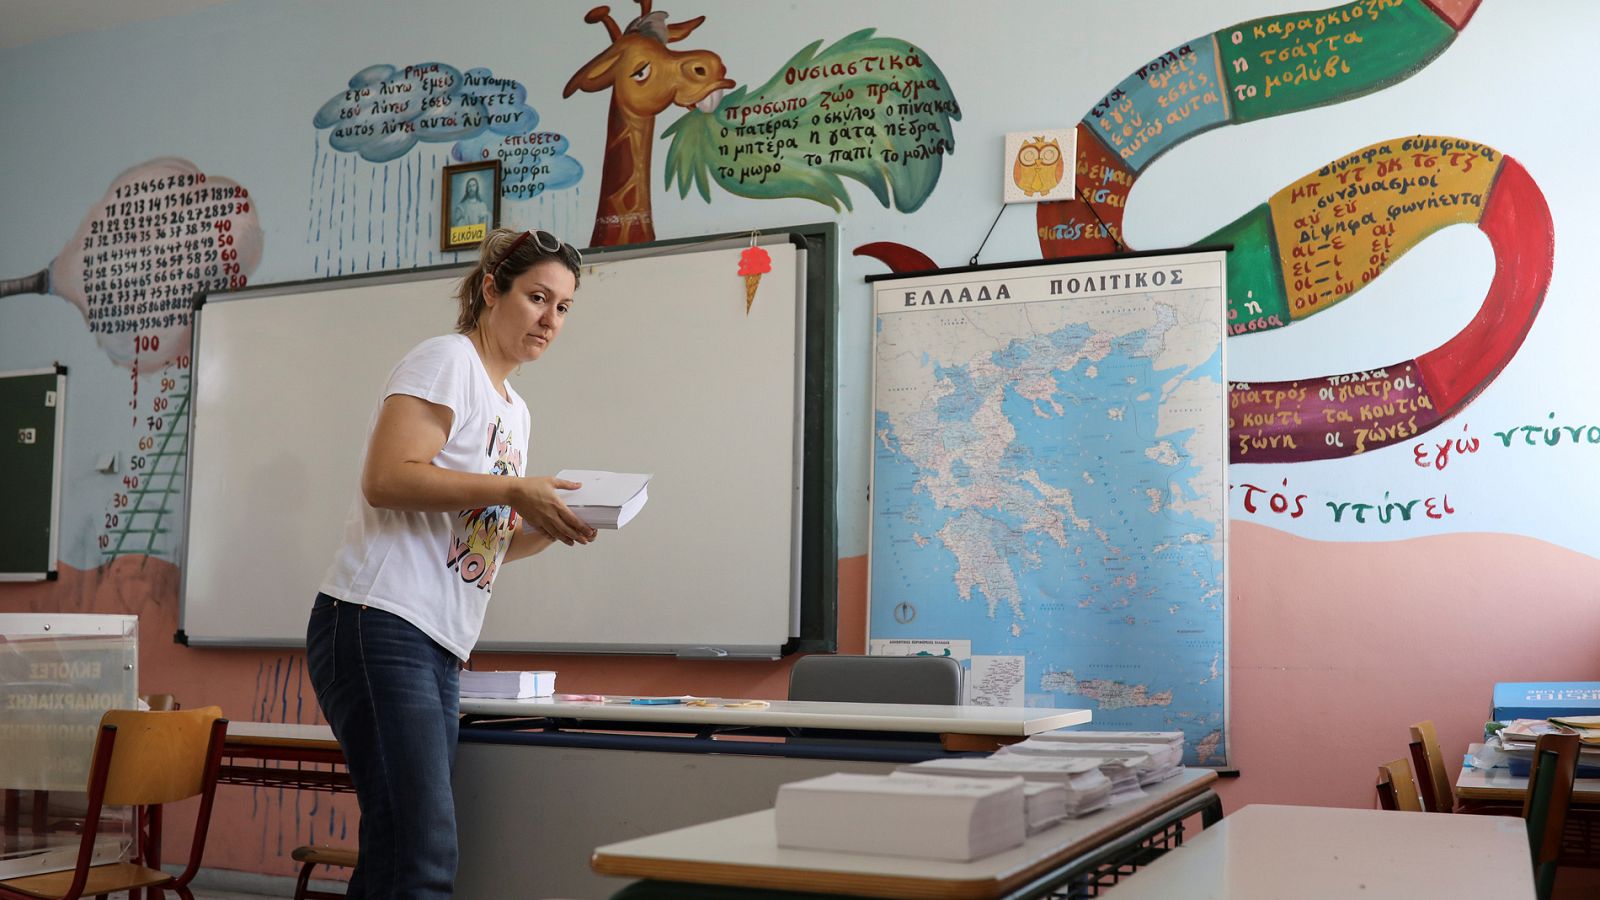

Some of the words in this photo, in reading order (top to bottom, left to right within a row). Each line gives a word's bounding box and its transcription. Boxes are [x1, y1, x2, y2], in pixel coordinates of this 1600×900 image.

[1261, 30, 1362, 64] τσάντα
[785, 48, 923, 84] Ουσιαστικά
[1234, 84, 1256, 100] το
[1265, 56, 1350, 97] μολύβι
[461, 91, 515, 107] λύνετε
[725, 96, 808, 124] πρόσωπο
[820, 84, 854, 110] ζώο
[867, 75, 940, 104] πράγμα
[736, 113, 798, 140] πατέρας
[824, 103, 876, 124] σκύλος
[734, 135, 798, 160] μητέρα
[830, 121, 876, 145] γάτα
[718, 166, 734, 179] το
[742, 156, 781, 182] μωρό
[804, 153, 822, 166] το
[830, 140, 872, 163] παπί
[880, 148, 898, 162] το
[501, 165, 550, 182] μορφη
[1292, 183, 1320, 204] μπ
[1377, 158, 1402, 177] γκ
[1412, 154, 1438, 168] τσ
[1449, 152, 1478, 172] τζ
[501, 182, 545, 198] μορφο
[218, 234, 234, 248] 50
[221, 249, 237, 262] 60
[224, 262, 240, 276] 70
[230, 275, 248, 288] 80
[904, 284, 1011, 306] ΕΛΛΑΔΑ
[1050, 269, 1184, 295] ΠΟΛΙΤΙΚΟΣ
[135, 336, 160, 354] 100
[160, 378, 175, 392] 90
[1232, 382, 1307, 409] γιατρός
[1319, 387, 1335, 402] οι
[154, 398, 168, 412] 80
[1322, 408, 1352, 424] τα
[1360, 386, 1432, 420] κουτιά
[147, 416, 163, 430] 70
[138, 437, 154, 450] 60
[1239, 429, 1296, 454] ζώνη
[1326, 432, 1344, 448] οι
[1354, 416, 1418, 454] ζώνες
[1414, 423, 1480, 471] εγώ
[130, 456, 146, 470] 50
[123, 476, 138, 488] 40
[114, 493, 128, 508] 30
[1326, 490, 1454, 524] ντύνει
[105, 513, 118, 528] 20
[98, 534, 109, 548] 10
